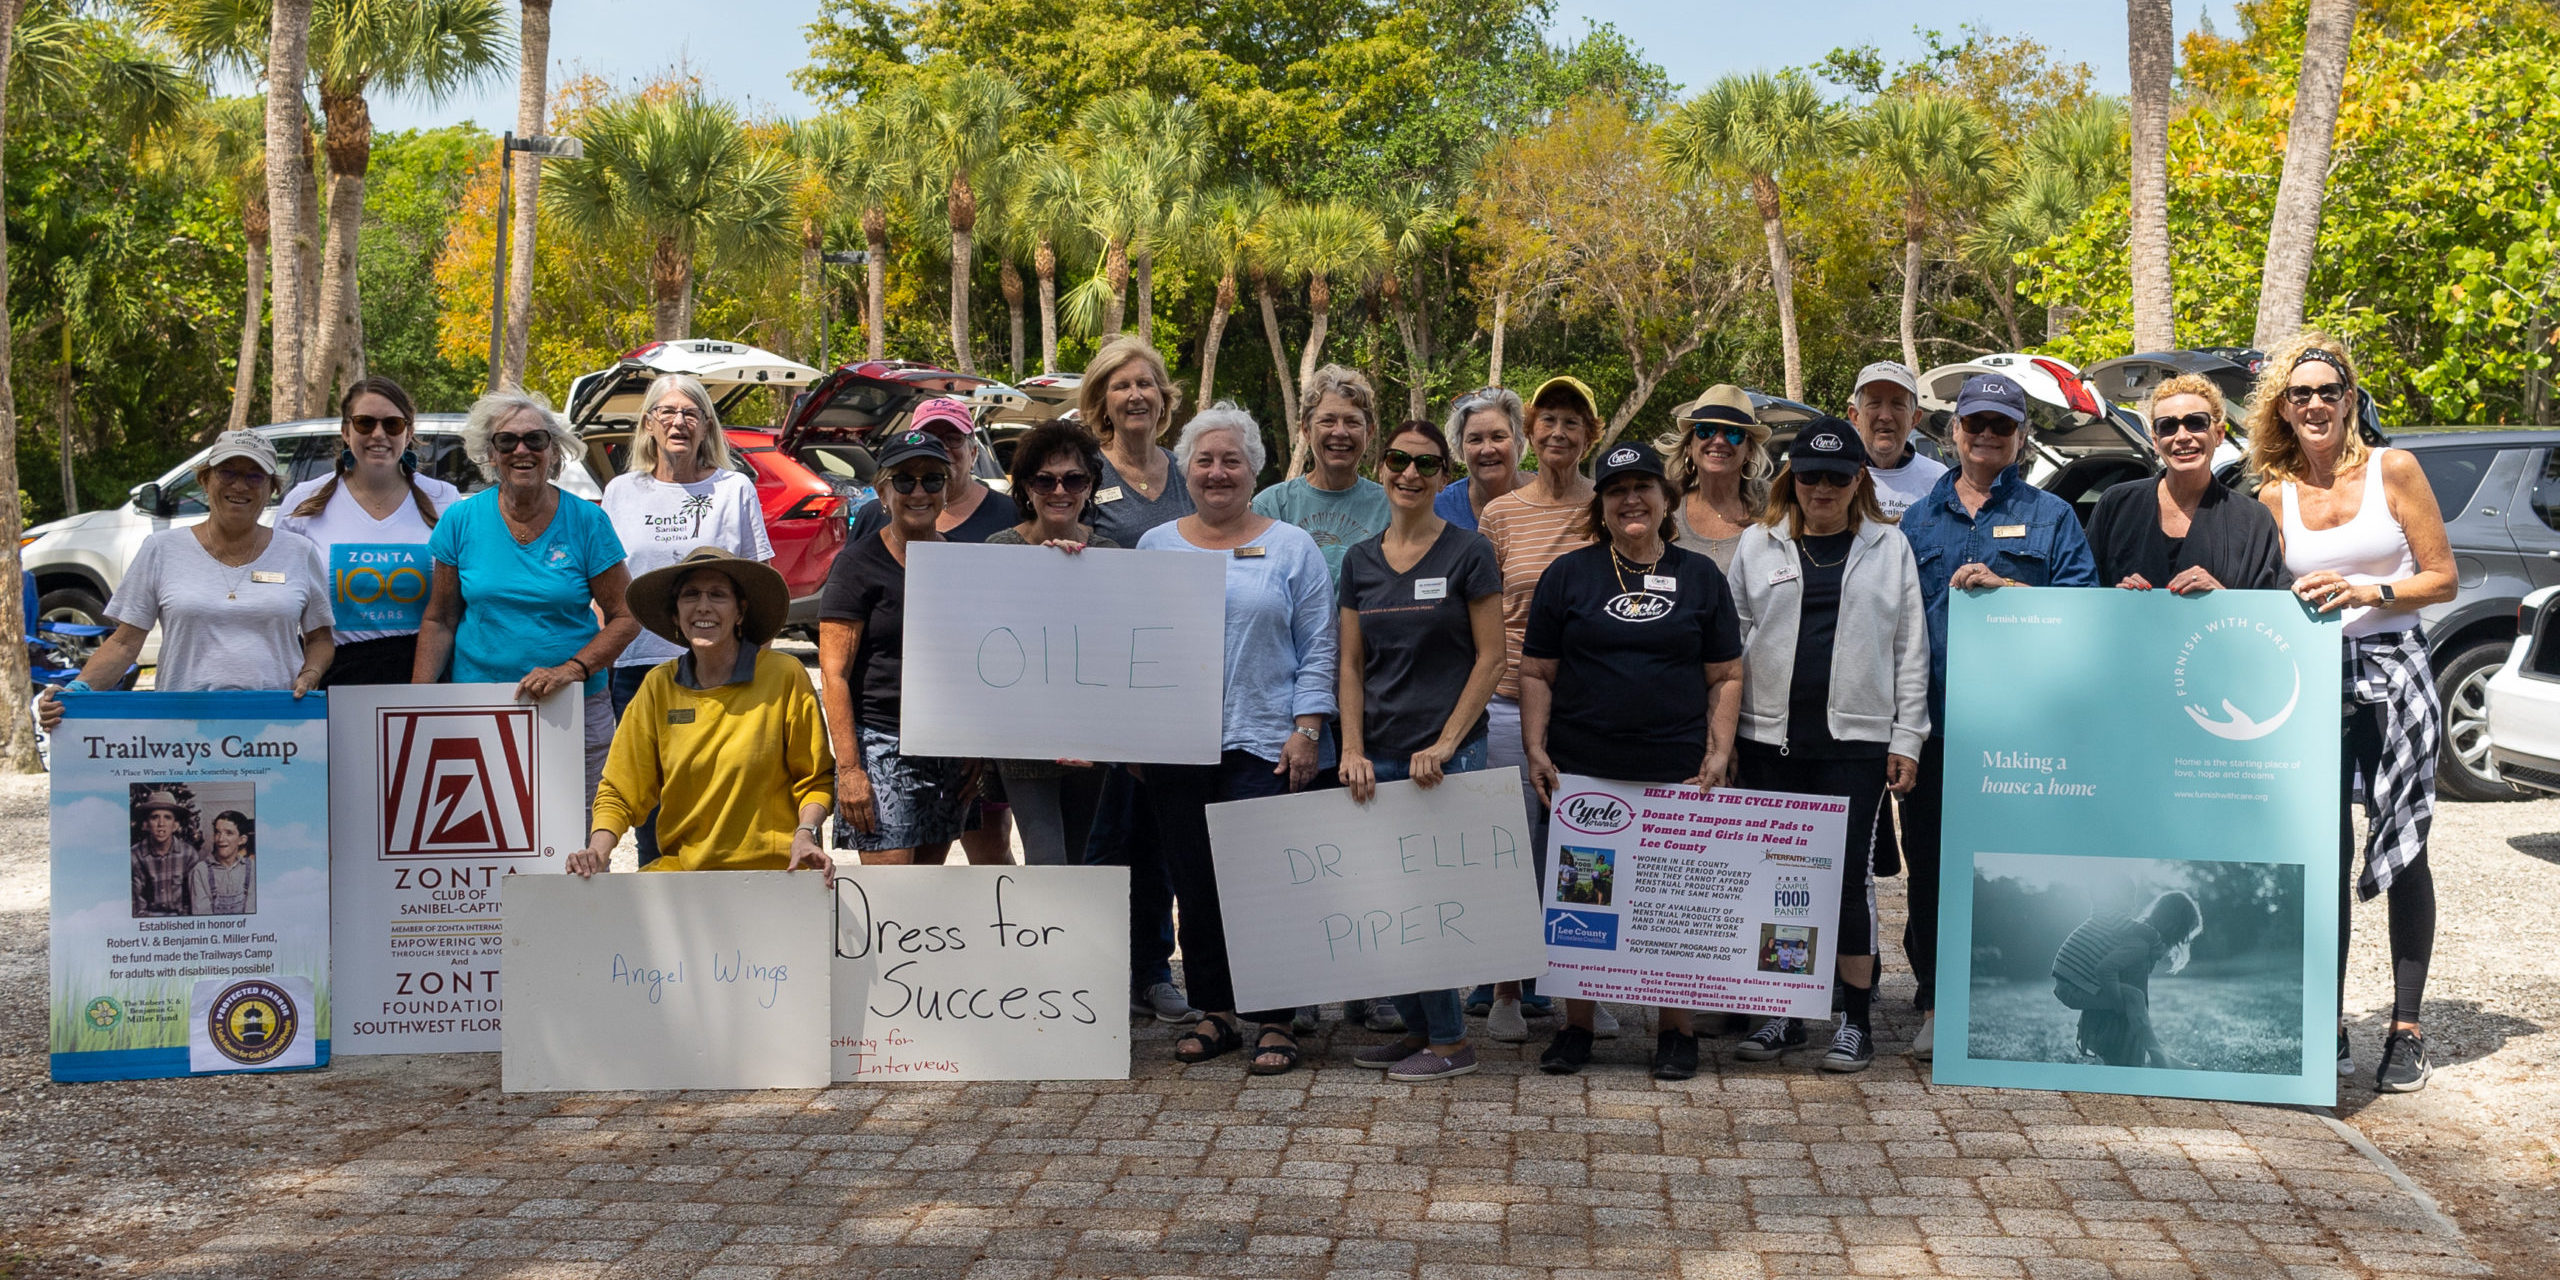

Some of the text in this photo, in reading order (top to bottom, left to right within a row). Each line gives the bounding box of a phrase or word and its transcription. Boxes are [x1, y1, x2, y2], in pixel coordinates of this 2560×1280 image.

[1982, 384, 2006, 395] LCA
[645, 514, 687, 525] Zonta
[655, 535, 687, 543] Captiva
[349, 552, 414, 563] ZONTA
[337, 567, 426, 603] 100
[360, 610, 403, 620] YEARS
[1986, 614, 2062, 625] furnish with care
[978, 624, 1178, 688] OILE
[2174, 617, 2291, 697] FURNISH WITH CARE
[84, 735, 298, 765] Trailways Camp
[1982, 750, 2066, 773] Making a
[2175, 758, 2301, 769] Home is the starting place of
[200, 768, 237, 777] Something
[2174, 770, 2275, 780] love, hope and dreams
[1982, 776, 2096, 797] house a home
[1644, 788, 1846, 813] HELP MOVE THE CYCLE FORWARD
[2174, 792, 2268, 801] www.furnishwithcare.org
[1568, 798, 1622, 824] Cycle
[1585, 818, 1621, 828] forward
[1642, 809, 1814, 832] Donate Tampons and Pads to
[1642, 824, 1807, 846] Women and Girls in Need in
[1640, 838, 1707, 853] Lee County
[1283, 825, 1519, 885] DR. ELLA
[1637, 855, 1667, 864] WOMEN
[1698, 860, 1729, 868] COUNTY
[1636, 871, 1659, 879] WHEN
[1684, 875, 1716, 884] CANNOT
[1718, 878, 1749, 886] AFFORD
[1637, 863, 1683, 873] EXPERIENCE
[1717, 870, 1751, 879] POVERTY
[1635, 878, 1681, 888] MENSTRUAL
[1684, 883, 1725, 892] PRODUCTS
[432, 889, 487, 900] CLUB OF
[1688, 890, 1709, 898] SAME
[1711, 892, 1742, 901] MONTH.
[1775, 891, 1810, 907] FOOD
[401, 902, 502, 915] SANIBEL-CAPTI
[1632, 908, 1678, 918] MENSTRUAL
[1681, 913, 1721, 921] PRODUCTS
[1633, 900, 1652, 908] LACK
[1668, 903, 1720, 914] AVAILABILITY
[1774, 908, 1809, 916] PANTRY
[833, 875, 1065, 959] Dress for
[139, 919, 246, 932] Established in honor of
[391, 925, 424, 933] MEMBER
[1318, 901, 1475, 962] PIPER
[1558, 927, 1607, 939] Lee County
[107, 933, 277, 948] Robert V. & Benjamin G. Miller Fund,
[391, 937, 502, 948] EMPOWERING WO
[112, 949, 272, 964] the fund made the Trailways Camp
[451, 958, 469, 966] And
[110, 964, 275, 980] for adults with disabilities possible!
[612, 950, 788, 1009] Angel Wings
[396, 970, 499, 995] ZONT
[870, 961, 1096, 1024] Success
[216, 987, 290, 1019] PROTECTED HARBOR
[383, 999, 502, 1014] FOUNDATIO
[353, 1019, 501, 1035] SOUTHWEST FLOR
[831, 1028, 914, 1052] othing for
[848, 1053, 959, 1076] Interviews
